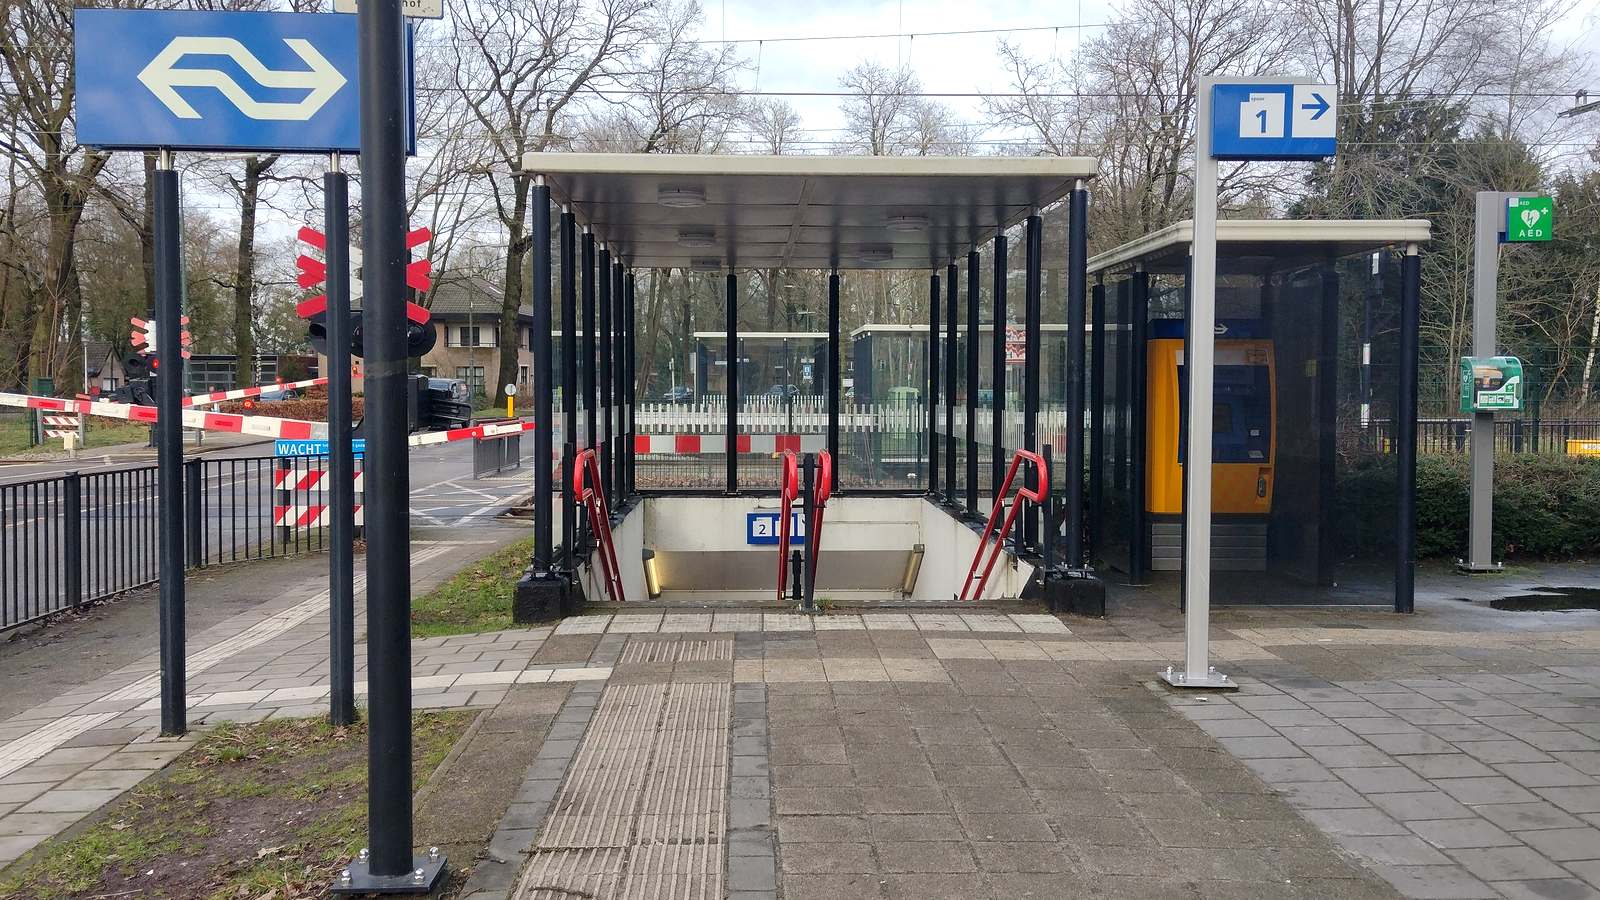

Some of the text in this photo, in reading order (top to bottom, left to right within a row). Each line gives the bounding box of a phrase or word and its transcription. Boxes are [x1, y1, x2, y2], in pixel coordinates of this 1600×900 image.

[1256, 109, 1267, 133] 1
[1519, 229, 1543, 237] AED
[277, 443, 322, 455] WACHT
[758, 524, 767, 535] 2
